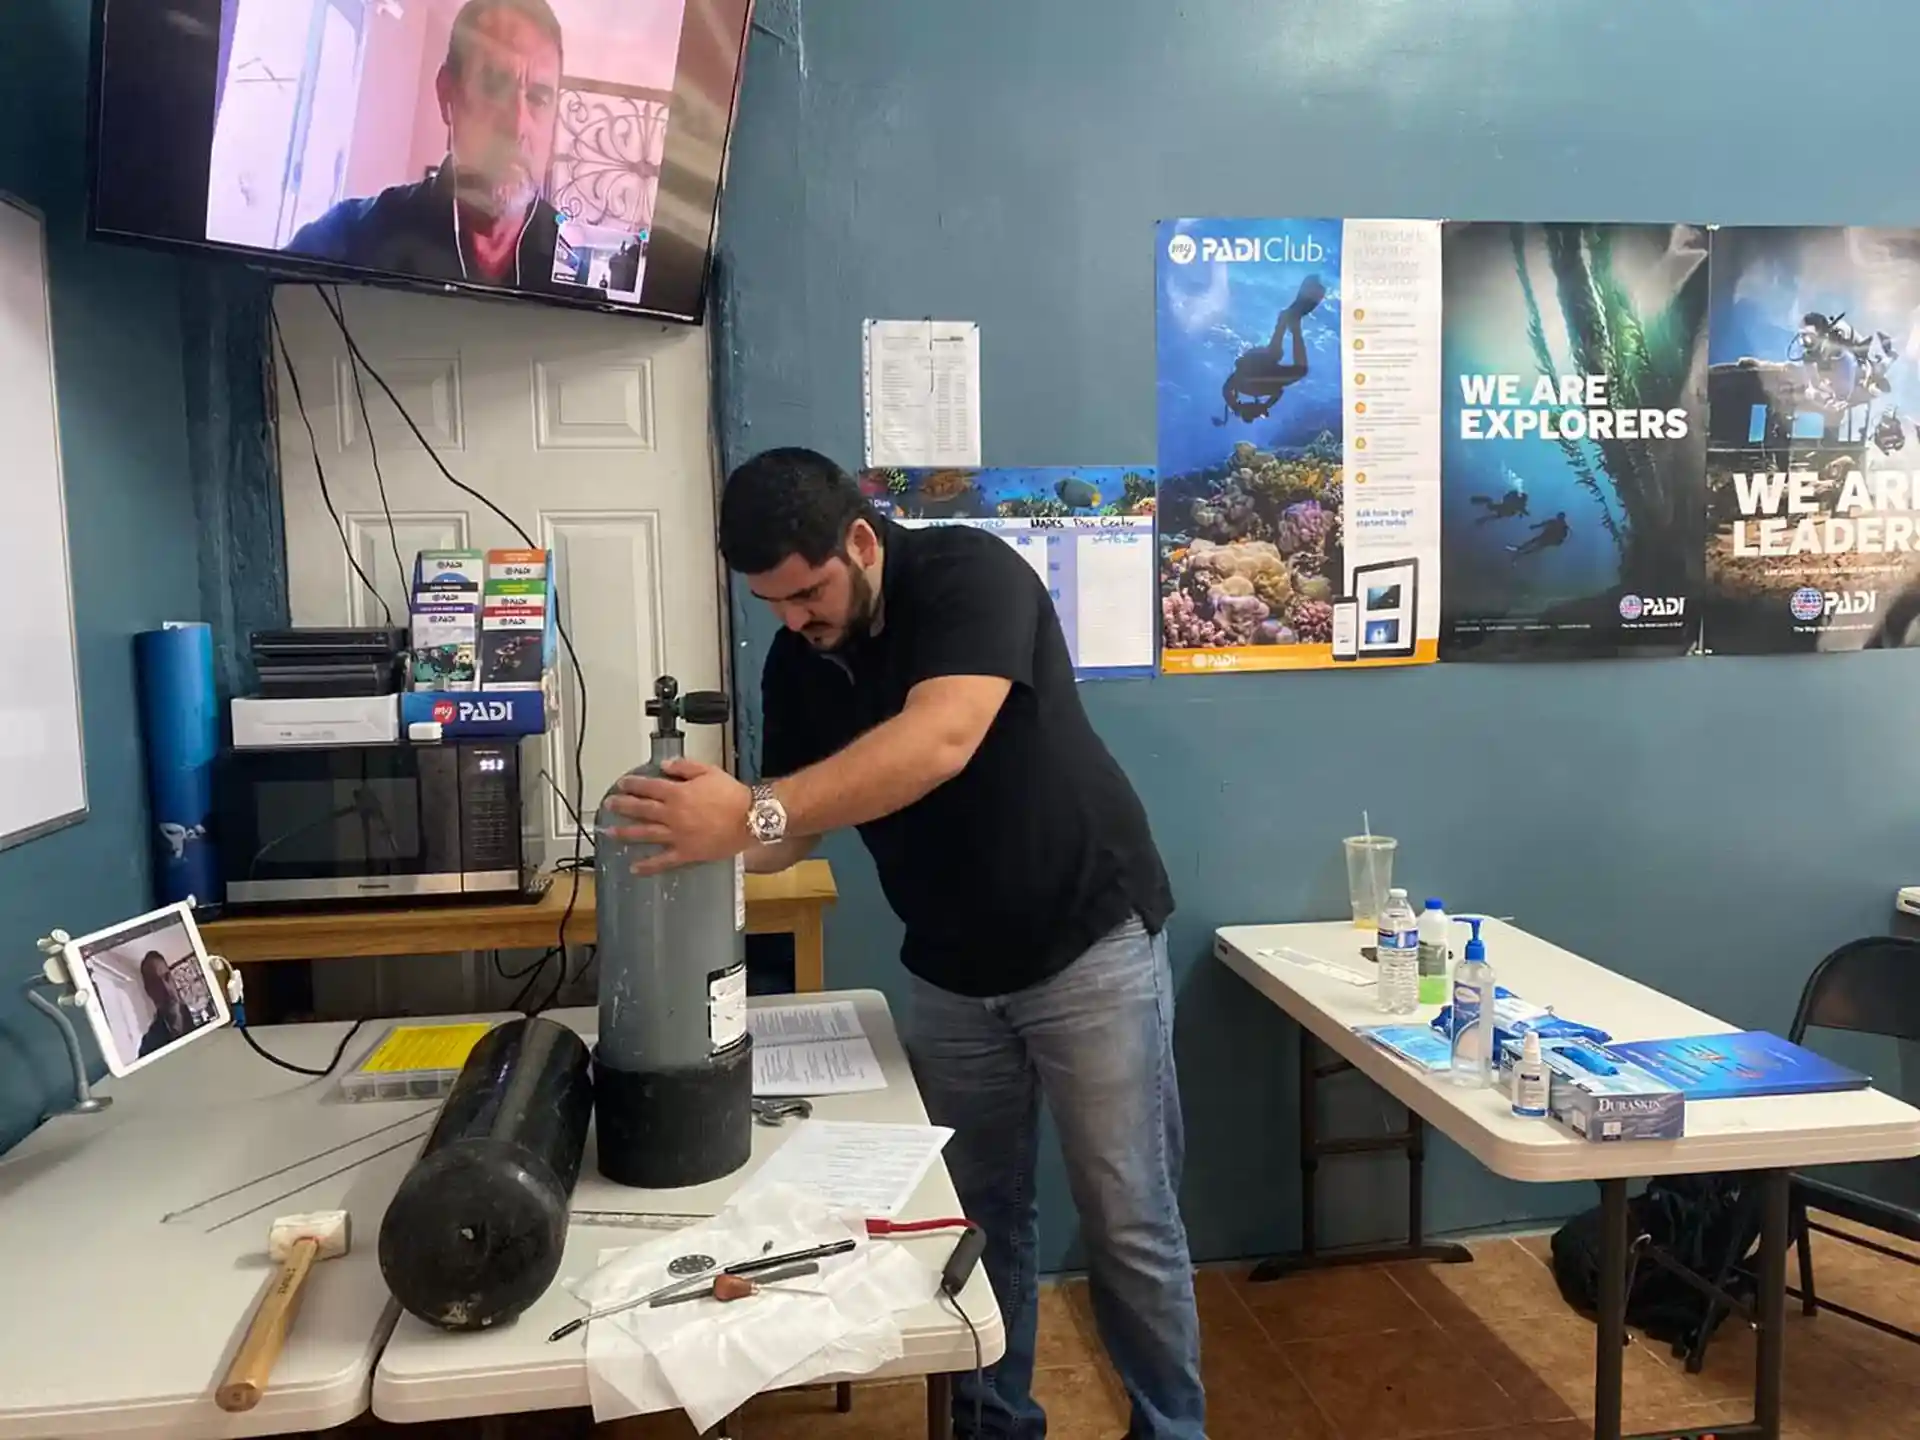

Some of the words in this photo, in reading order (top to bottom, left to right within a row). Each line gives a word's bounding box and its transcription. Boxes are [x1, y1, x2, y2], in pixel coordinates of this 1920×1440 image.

[1172, 242, 1192, 259] my
[1202, 238, 1260, 262] PADI
[1264, 234, 1322, 262] Club
[1460, 374, 1520, 405] WE
[1530, 374, 1608, 406] ARE
[1460, 408, 1688, 440] EXPLORERS
[1733, 471, 1820, 516] WE
[1836, 469, 1920, 513] AR
[1733, 516, 1920, 557] LEADER
[1643, 597, 1686, 616] PADI
[1824, 590, 1877, 616] PADI
[433, 705, 453, 720] my
[459, 701, 514, 721] PADI
